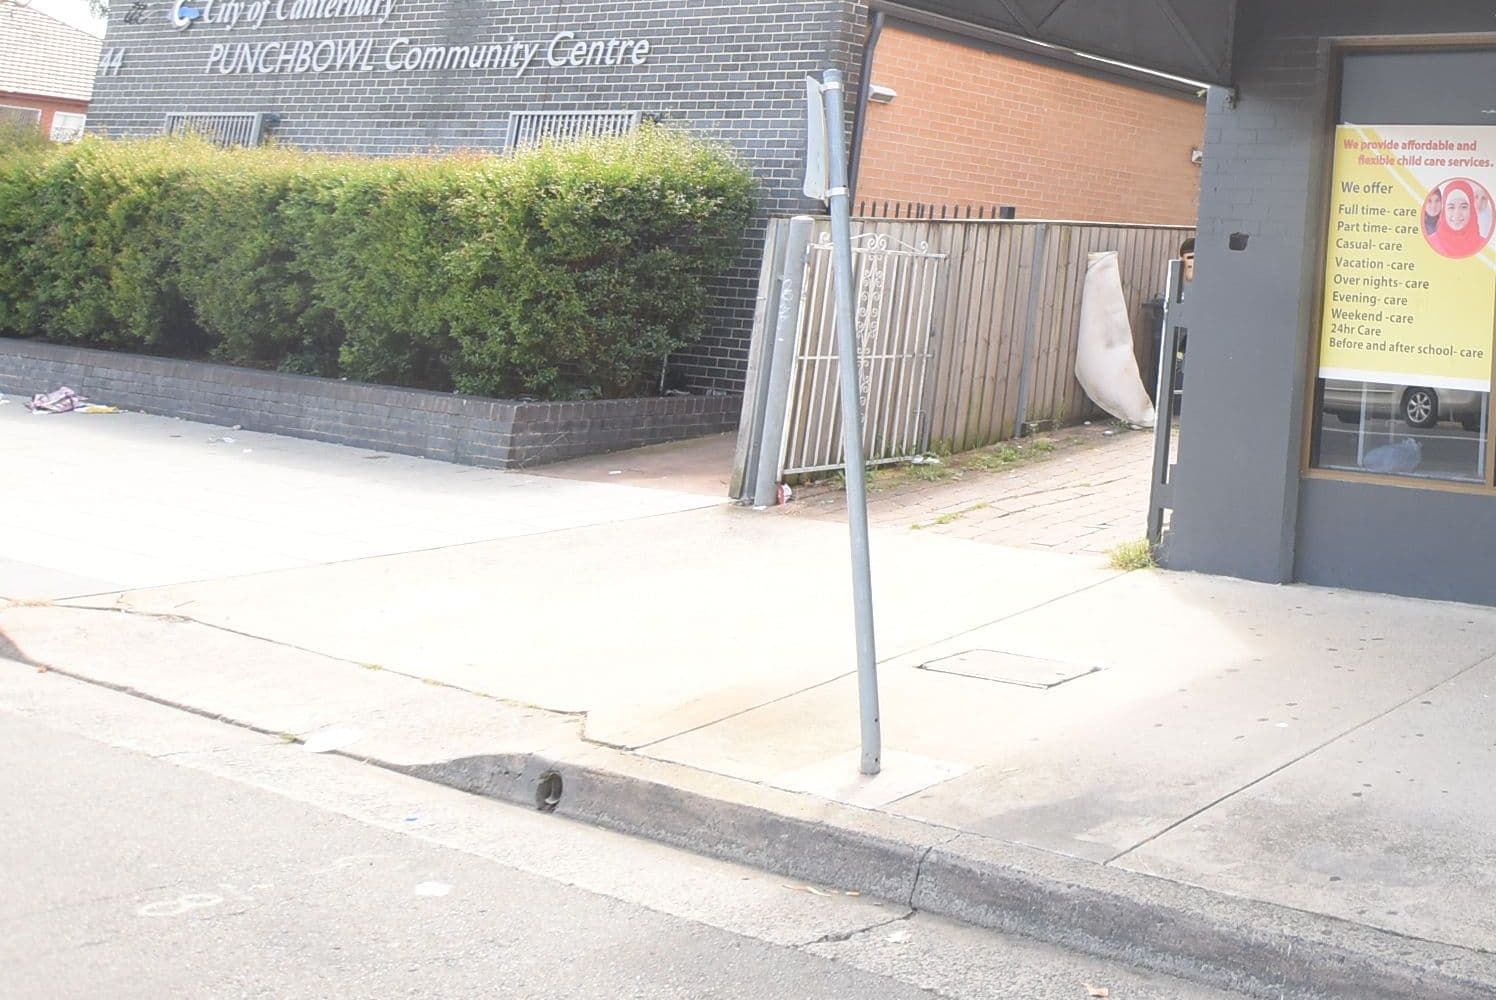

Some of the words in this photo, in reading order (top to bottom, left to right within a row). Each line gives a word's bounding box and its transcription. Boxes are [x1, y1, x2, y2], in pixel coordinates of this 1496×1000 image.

[205, 37, 375, 75] PUNCHBOWL
[385, 37, 541, 77] Community
[546, 32, 650, 67] Centre
[100, 47, 126, 76] 44
[1343, 139, 1358, 150] We
[1360, 139, 1398, 152] provide
[1401, 140, 1454, 151] affordable
[1456, 140, 1477, 152] and
[1358, 155, 1394, 167] flexible
[1396, 155, 1420, 167] child
[1423, 157, 1445, 167] care
[1448, 156, 1494, 168] services.
[1341, 181, 1359, 194] We
[1362, 182, 1394, 195] offer
[1338, 204, 1358, 216] Full
[1393, 207, 1417, 217] care
[1337, 221, 1359, 233] Part
[1394, 225, 1419, 234] care
[1378, 241, 1402, 251] care
[1335, 257, 1384, 270] Vacation
[1333, 274, 1360, 286] Over
[1405, 279, 1430, 289] care
[1383, 296, 1408, 306] care
[1331, 309, 1383, 322] Weekend
[1331, 324, 1354, 335] 24hr
[1357, 325, 1381, 337] Care
[1330, 338, 1363, 350] Before
[1366, 341, 1386, 351] and
[1389, 341, 1415, 353] after
[1460, 348, 1484, 358] care
